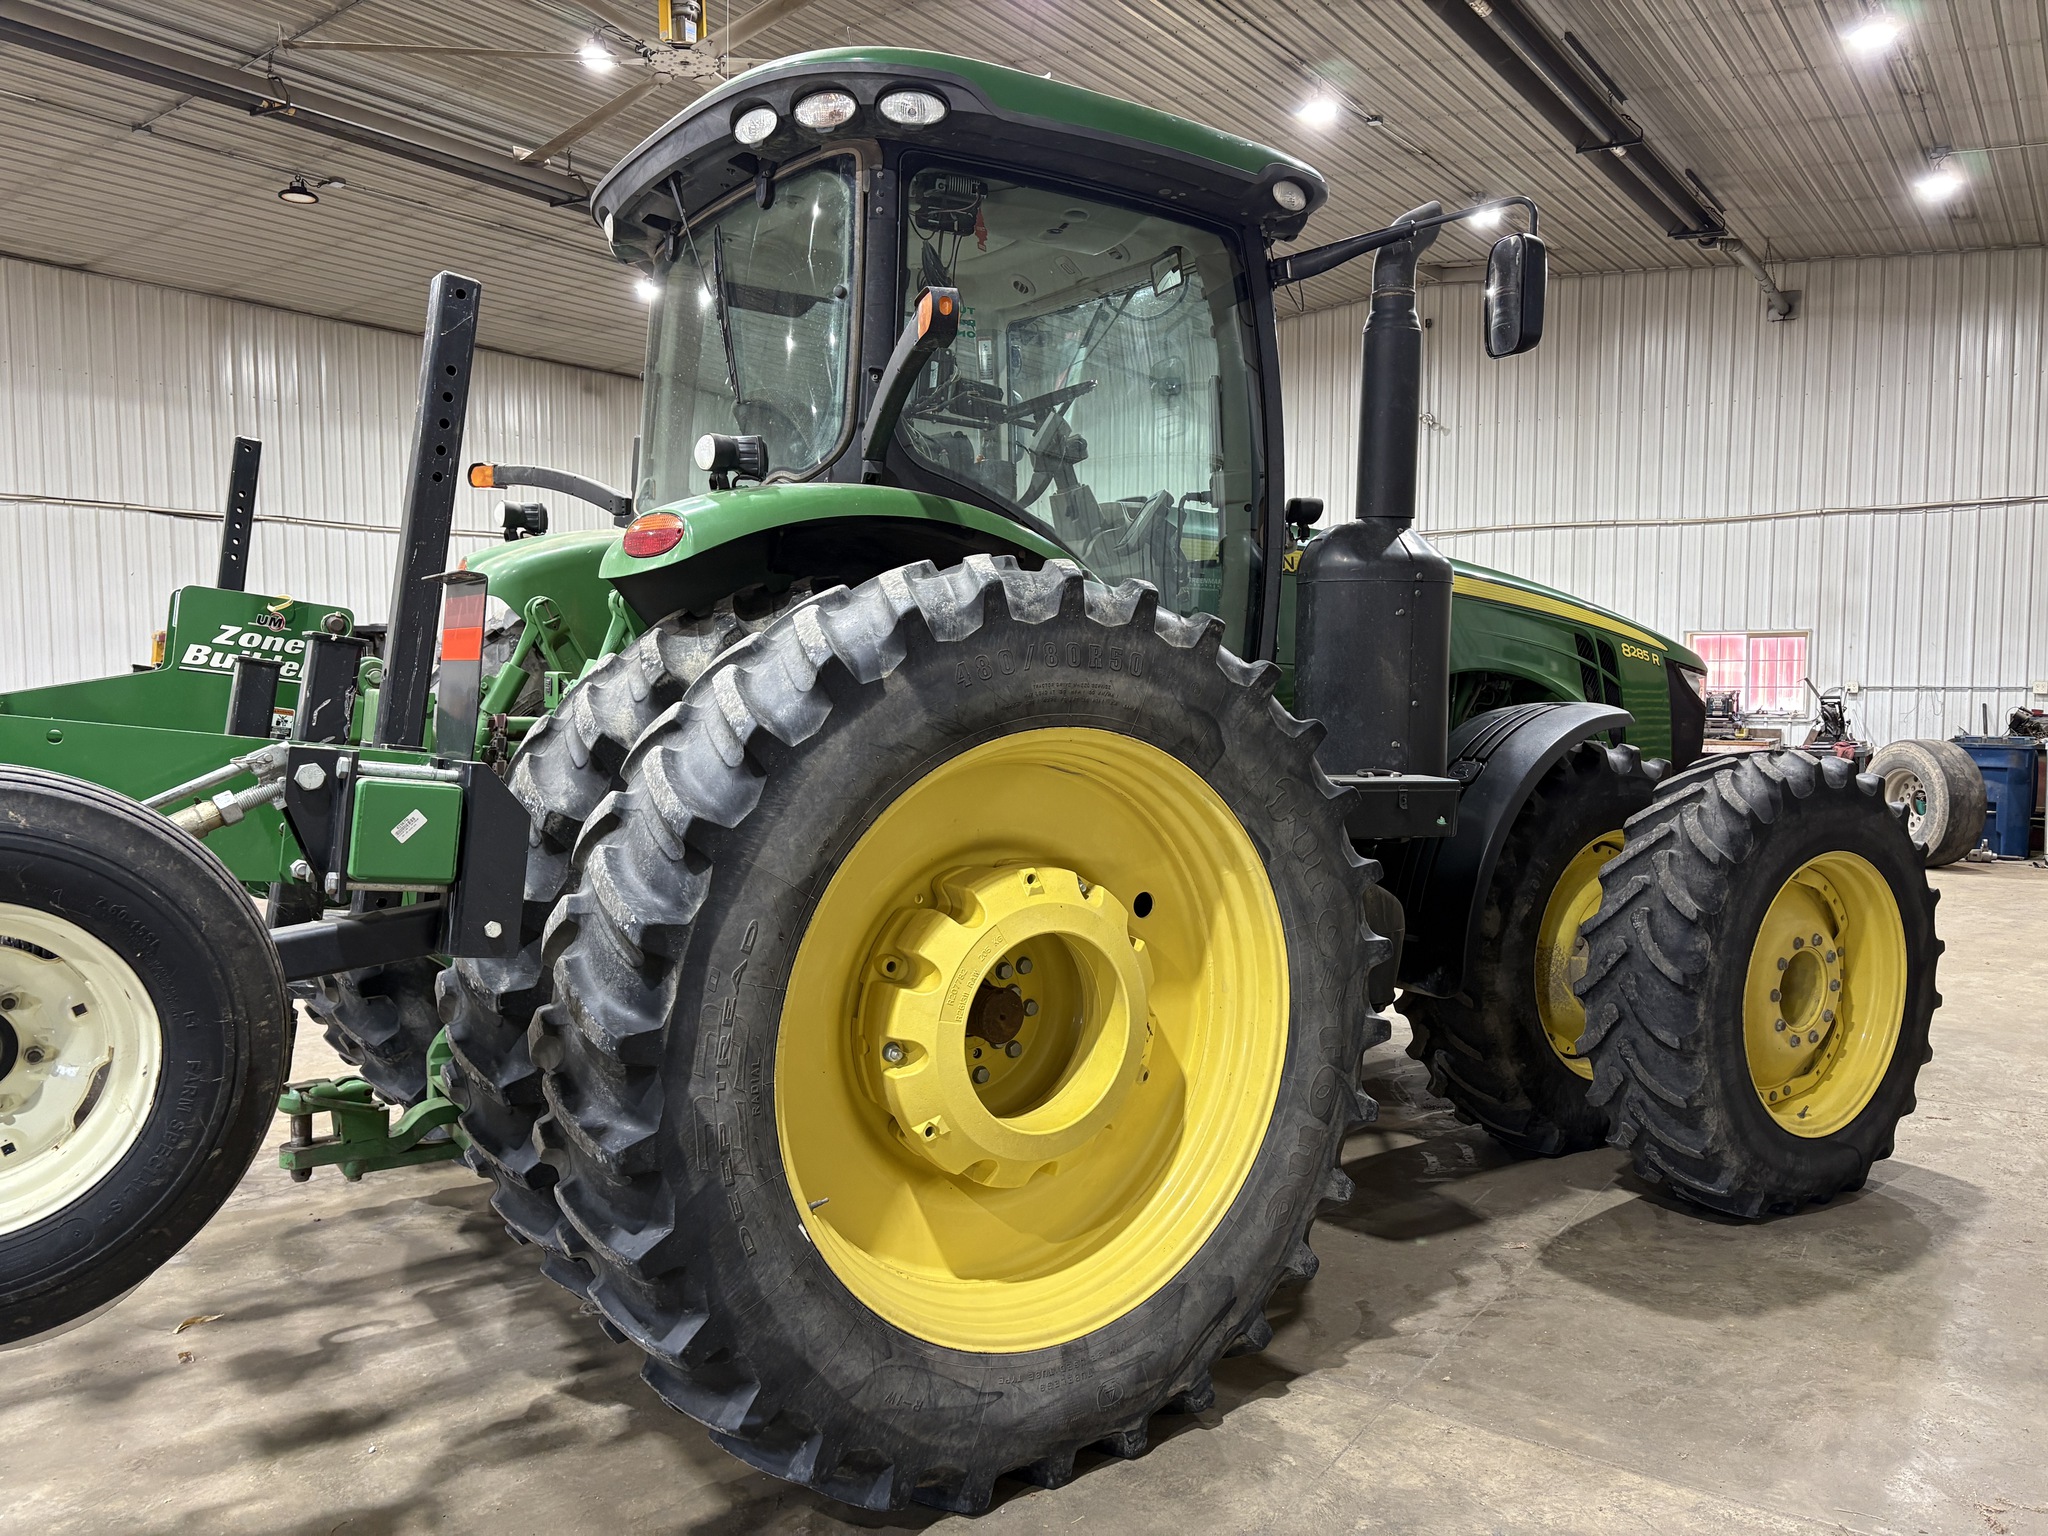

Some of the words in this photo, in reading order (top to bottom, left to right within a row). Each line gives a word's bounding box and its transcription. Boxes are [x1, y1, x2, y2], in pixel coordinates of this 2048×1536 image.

[211, 624, 306, 655] Zone
[954, 641, 1145, 689] 480/80R50
[1621, 642, 1650, 662] 8285
[1651, 653, 1661, 666] R
[714, 919, 759, 1101] TREAD
[1264, 776, 1347, 1233] Firestone
[176, 1060, 201, 1113] FARM
[750, 1056, 762, 1117] RADIAL
[101, 1119, 185, 1225] SPECIALIST
[719, 1122, 756, 1257] DEEP
[884, 1391, 924, 1413] R-1W
[998, 1376, 1023, 1385] TYPE
